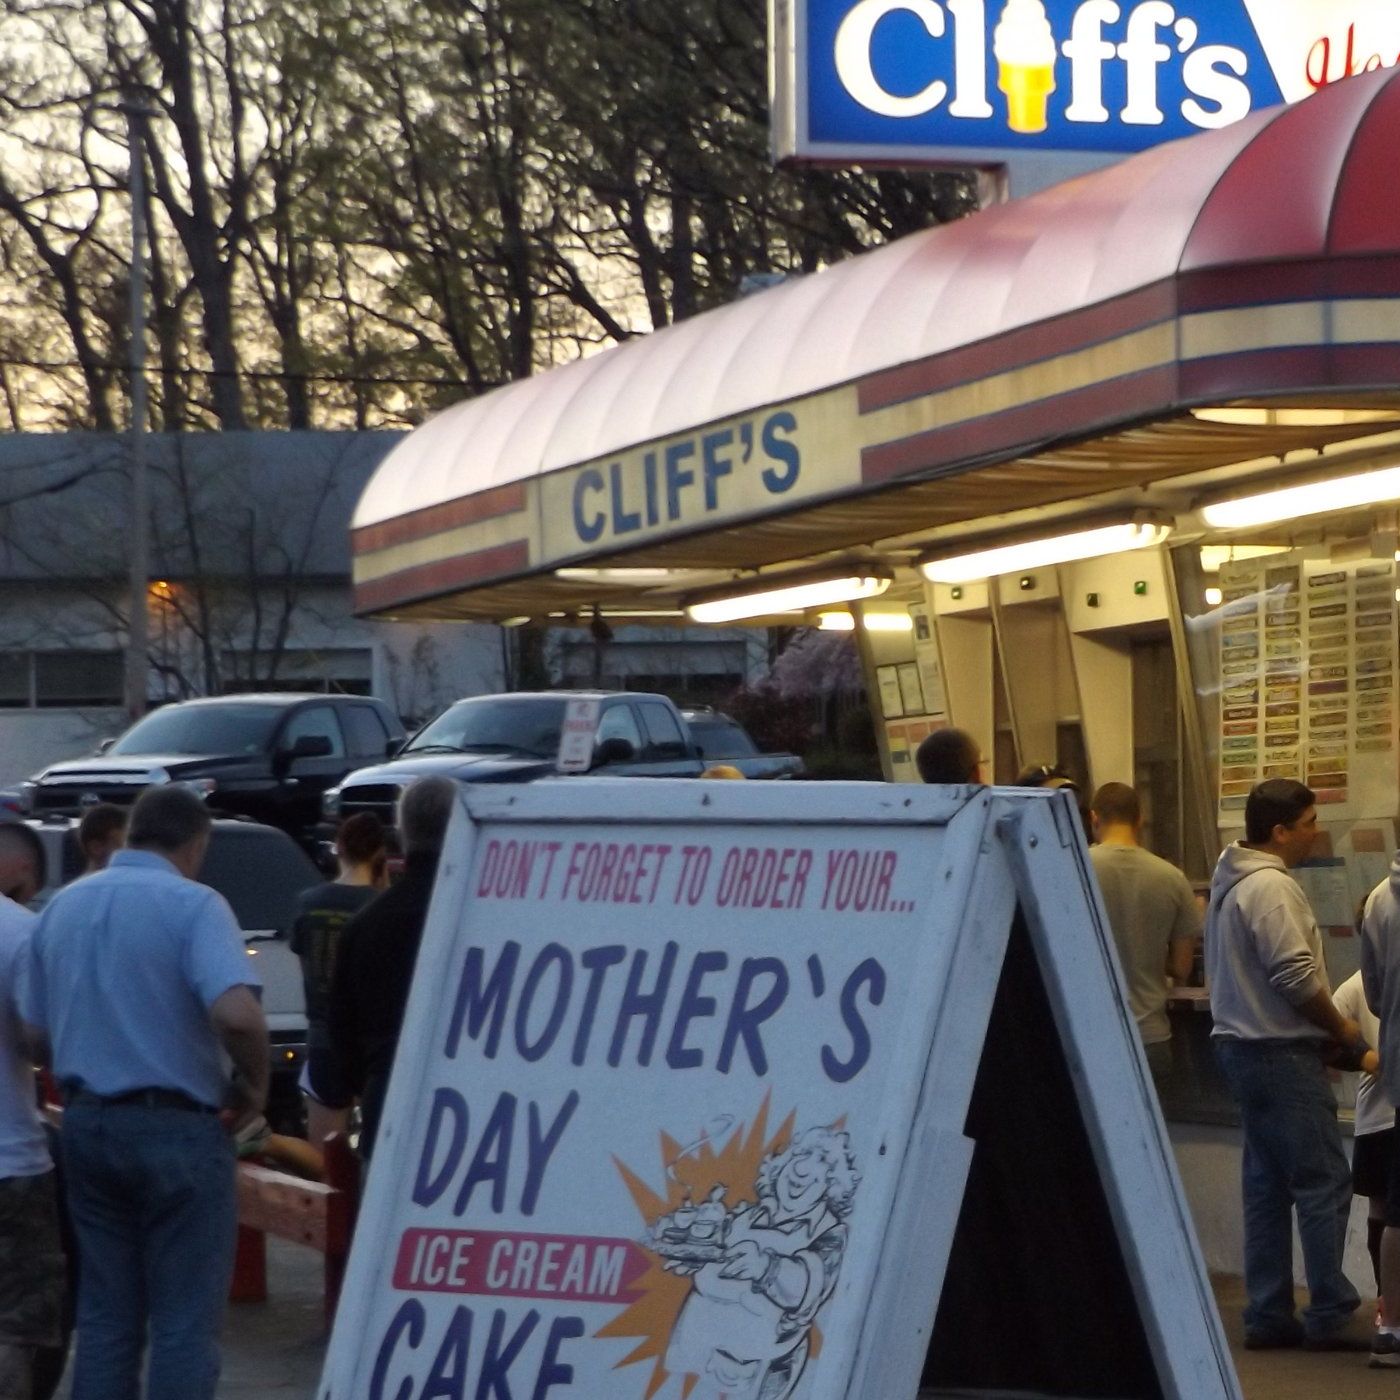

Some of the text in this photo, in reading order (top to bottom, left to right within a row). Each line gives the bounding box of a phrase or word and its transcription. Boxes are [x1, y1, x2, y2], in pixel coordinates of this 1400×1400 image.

[572, 411, 801, 543] CLIFF'S
[476, 839, 915, 913] DON'T FORGET TO ORDER YOUR...
[411, 1086, 580, 1216] DAY
[410, 1234, 629, 1297] ICE CREAM
[369, 1298, 585, 1400] CAKE
